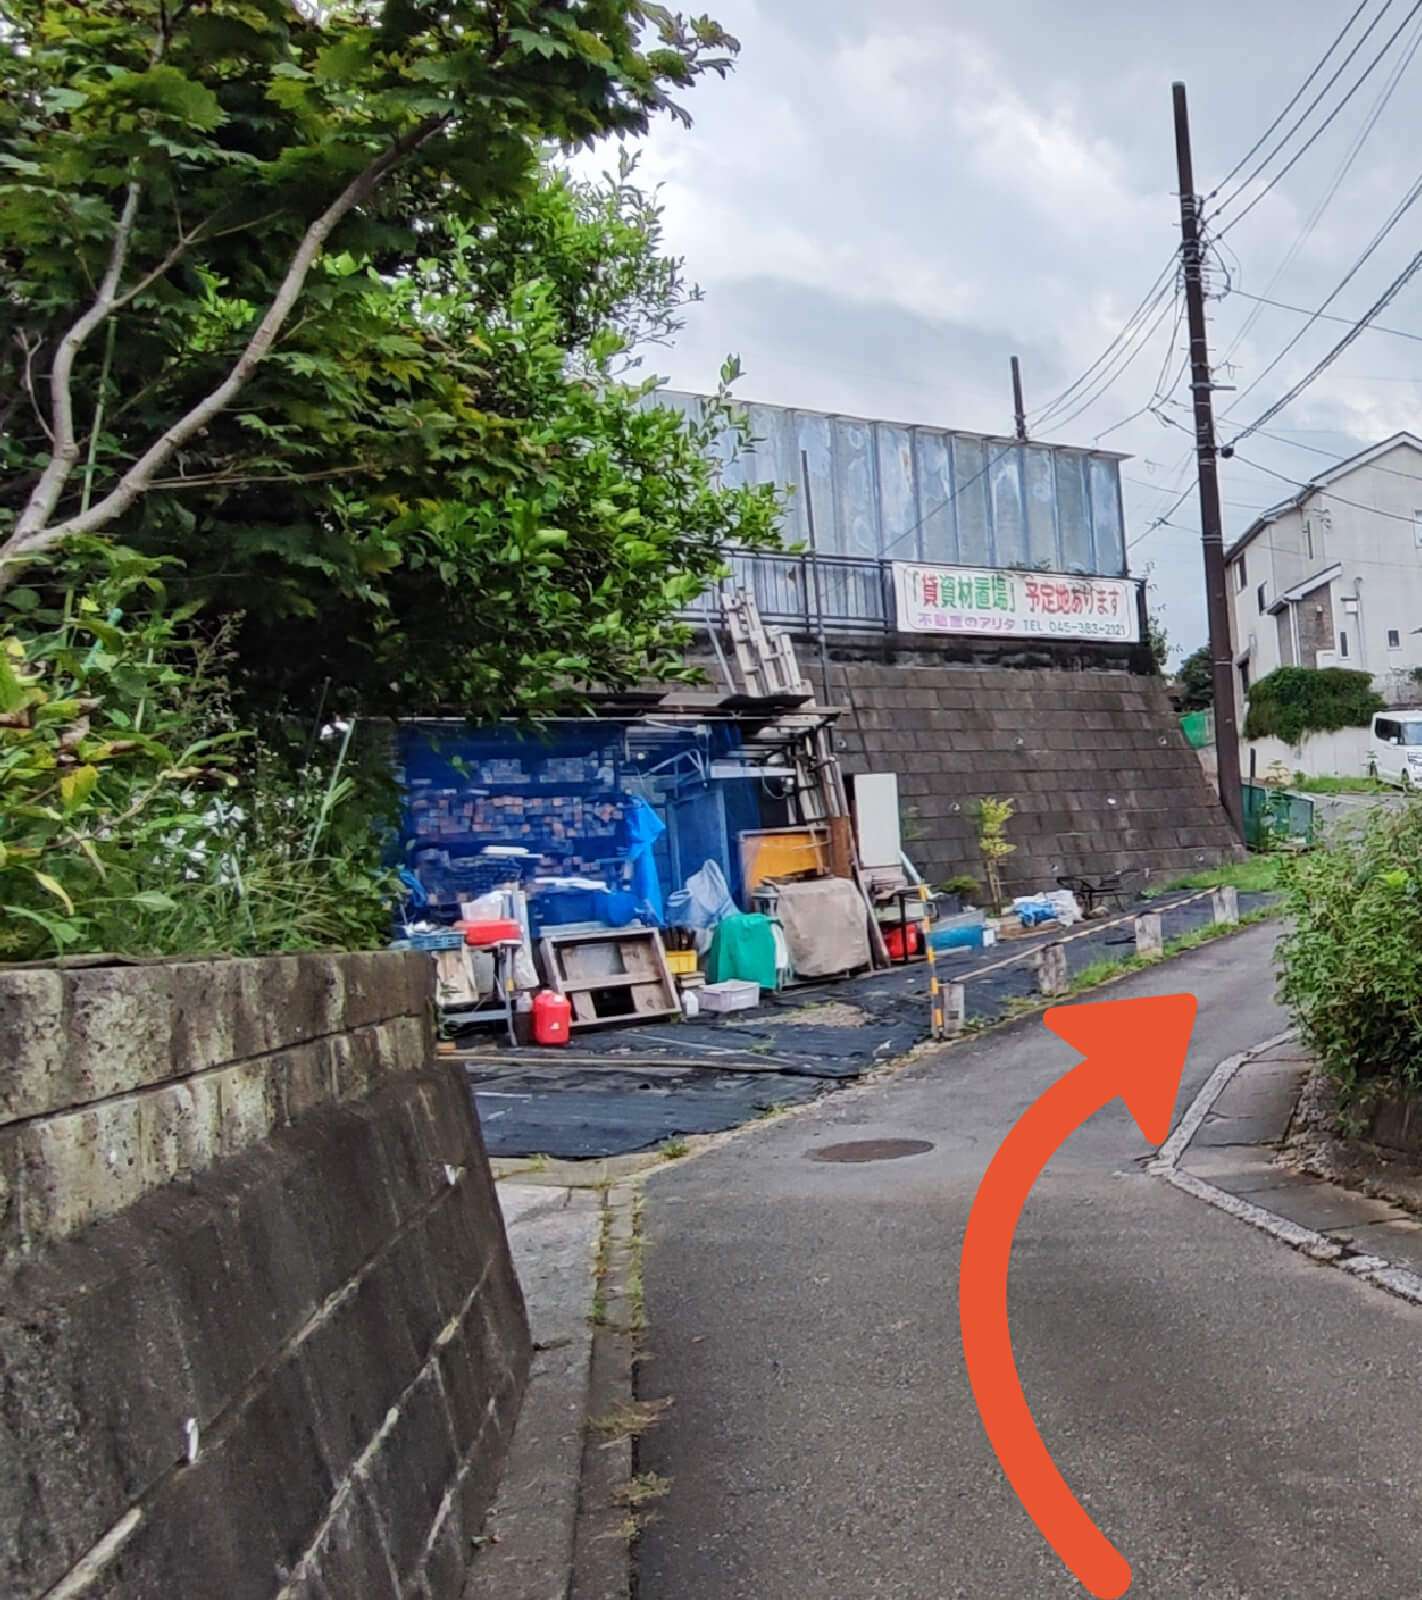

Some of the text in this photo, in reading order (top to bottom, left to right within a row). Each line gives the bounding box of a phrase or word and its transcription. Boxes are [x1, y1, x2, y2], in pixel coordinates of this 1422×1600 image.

[1025, 582, 1119, 616] 予定地あります
[1024, 619, 1043, 632] TEL
